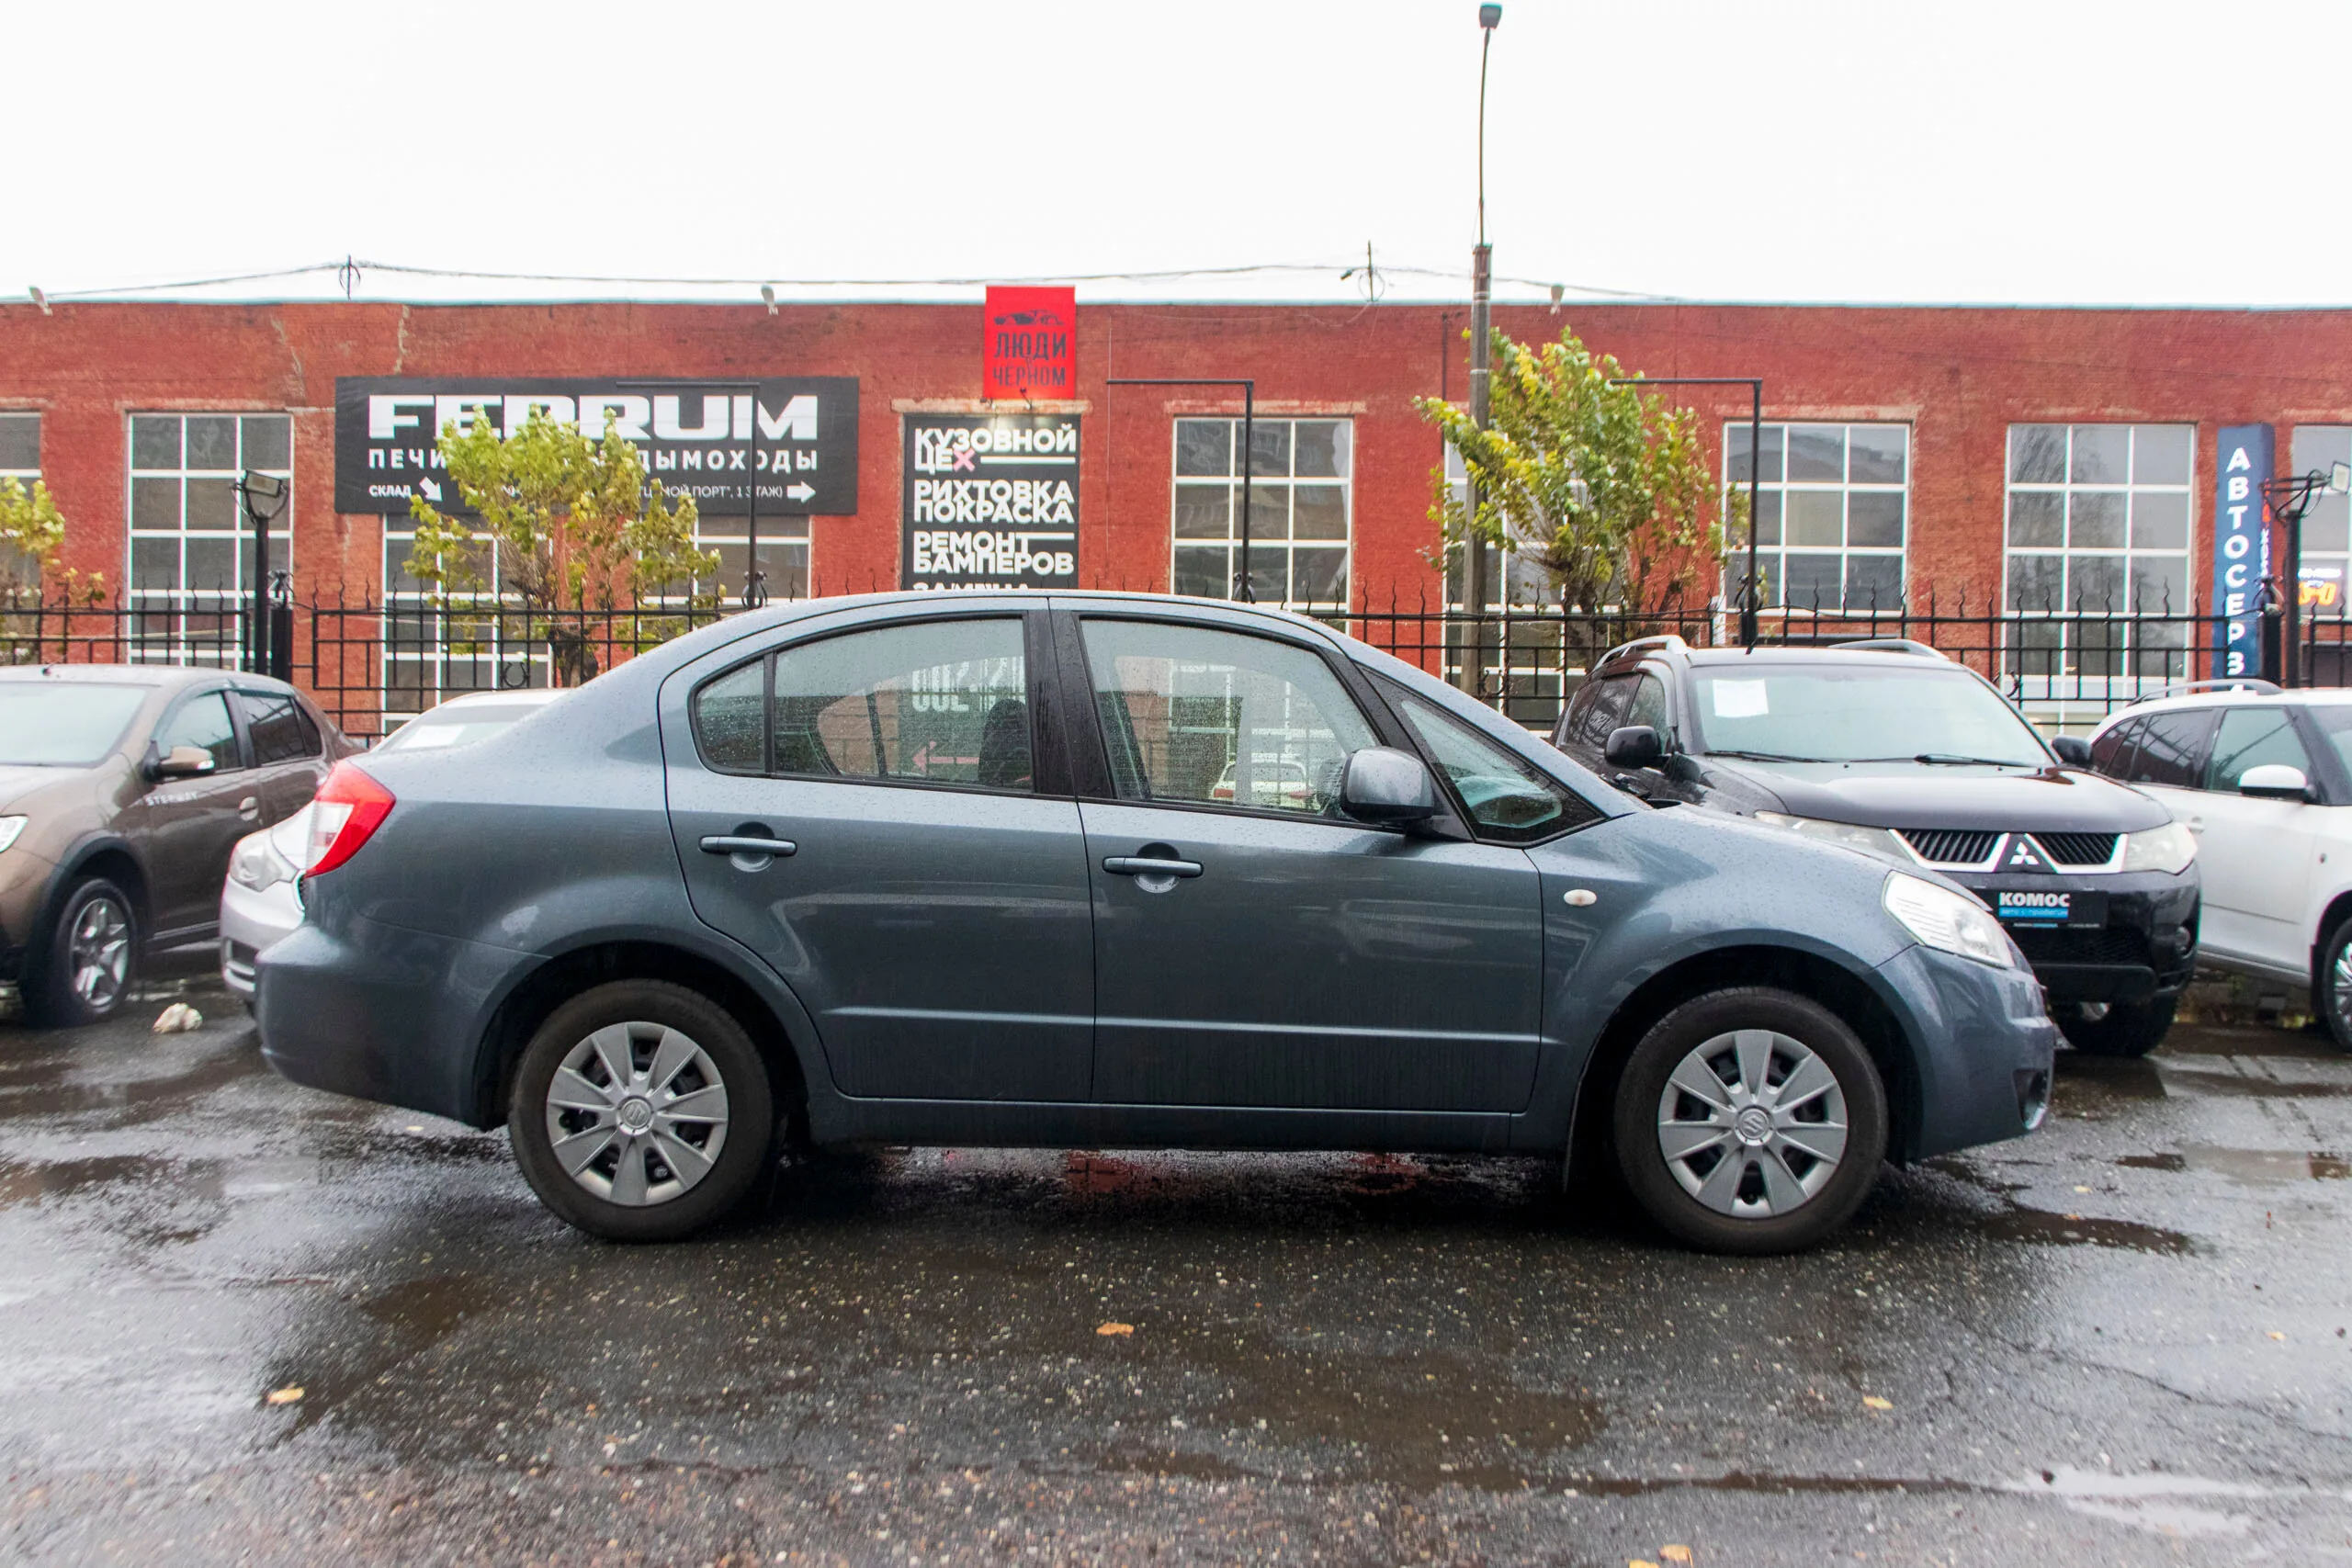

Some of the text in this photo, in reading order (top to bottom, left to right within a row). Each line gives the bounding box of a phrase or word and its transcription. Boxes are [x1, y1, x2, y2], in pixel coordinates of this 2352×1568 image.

[993, 333, 1067, 360] ЛЮДИ
[914, 423, 1077, 453] КУЗОВНОЙ
[368, 448, 447, 469] ПЕЧИ
[914, 446, 976, 475] ЦЕХ
[368, 484, 413, 499] СКЛАД
[914, 479, 1075, 504] РИХТОВКА
[914, 499, 1075, 524] ПОКРАСКА
[913, 531, 1030, 555] РЕМОНТ
[913, 551, 1075, 576] БАМПЕРОВ
[1998, 891, 2071, 908] КОМОС
